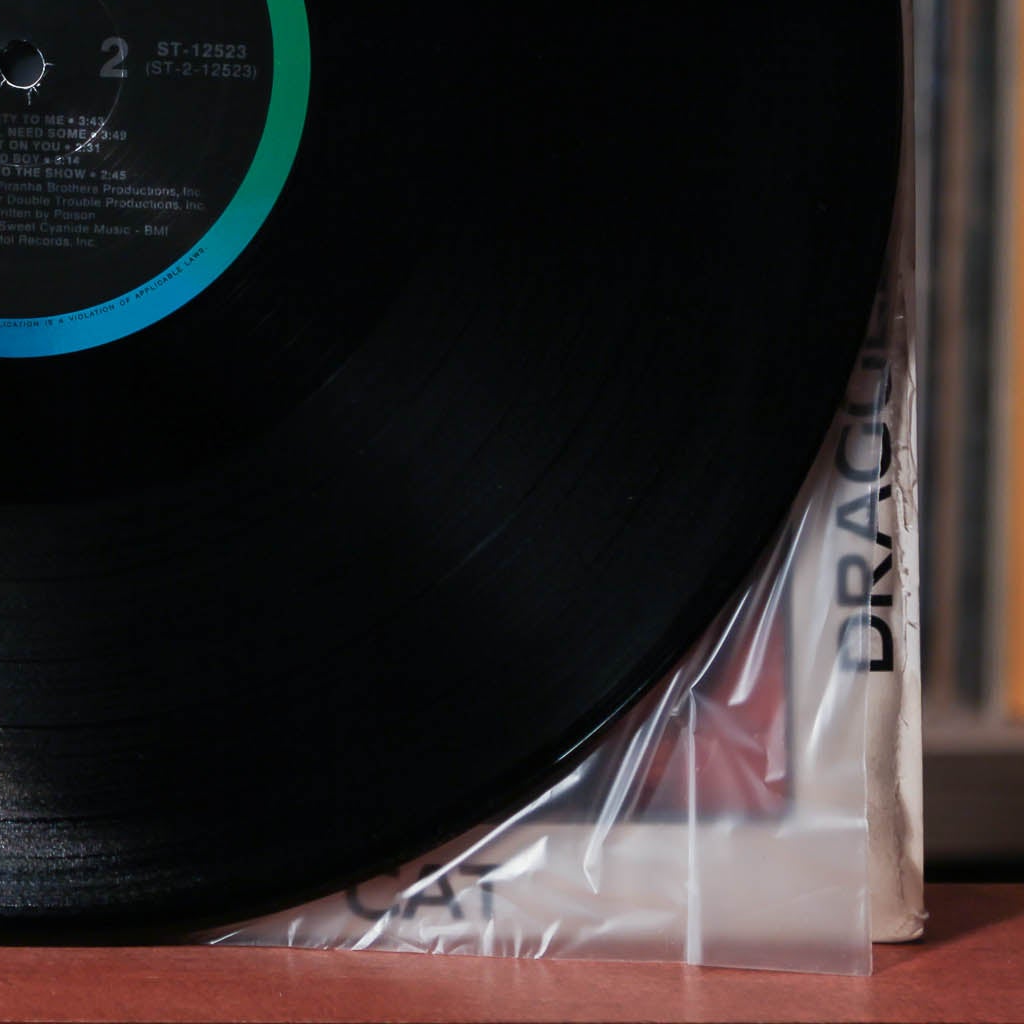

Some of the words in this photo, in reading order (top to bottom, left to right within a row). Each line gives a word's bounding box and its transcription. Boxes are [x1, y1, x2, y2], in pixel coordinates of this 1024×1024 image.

[99, 36, 129, 78] 2
[157, 41, 247, 59] ST-12523
[145, 60, 257, 80] (ST-2-12523)
[22, 114, 40, 124] TO
[44, 114, 65, 125] ME
[7, 126, 43, 138] NEED
[47, 128, 87, 139] SOME
[9, 140, 28, 151] ON
[33, 140, 61, 152] YOU
[12, 153, 40, 164] BOY
[15, 166, 41, 178] THE
[45, 167, 86, 179] SHOW
[47, 181, 98, 194] Brothers
[103, 184, 180, 198] Productions,
[7, 194, 51, 207] Double
[56, 195, 101, 207] Trouble
[35, 208, 50, 222] by
[54, 208, 96, 220] Poison
[39, 222, 89, 236] Cyanide
[94, 223, 130, 235] Music
[144, 224, 169, 237] BMI
[68, 304, 115, 322] VIOLATION
[119, 297, 131, 307] OF
[135, 266, 184, 299] APPLICABLE
[346, 863, 504, 921] CAT
